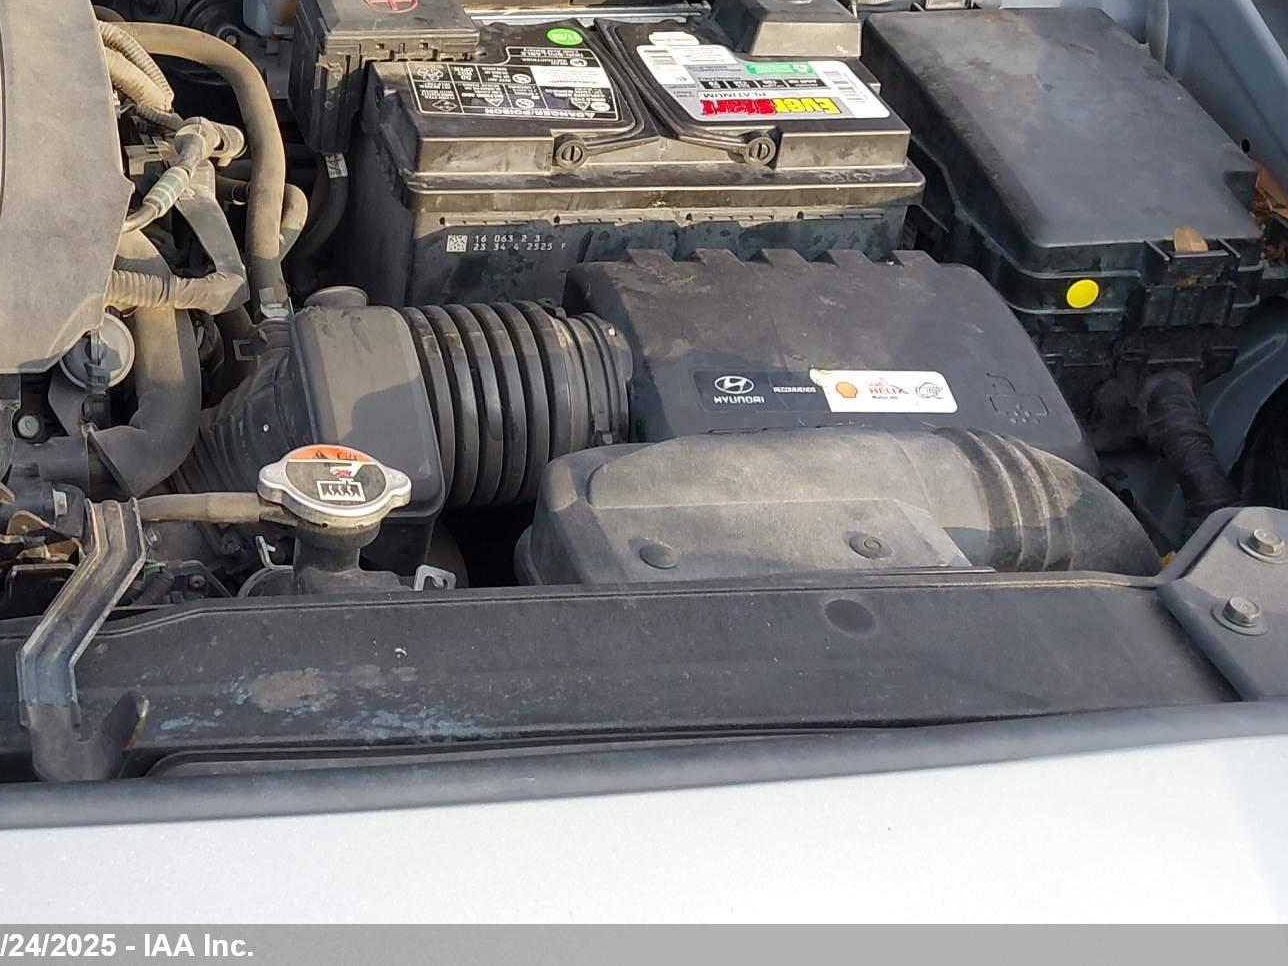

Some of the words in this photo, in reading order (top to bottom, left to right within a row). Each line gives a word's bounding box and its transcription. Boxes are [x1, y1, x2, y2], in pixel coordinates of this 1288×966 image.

[700, 96, 841, 116] EverStart
[474, 234, 487, 243] 16
[494, 234, 514, 243] 063
[521, 234, 527, 243] 2
[534, 234, 541, 243] 3
[472, 243, 486, 251] 23
[493, 243, 506, 251] 34
[513, 243, 520, 251] 4
[526, 243, 553, 251] 2525
[773, 386, 817, 394] RECOMMENDS
[713, 395, 765, 404] HYUNDAI
